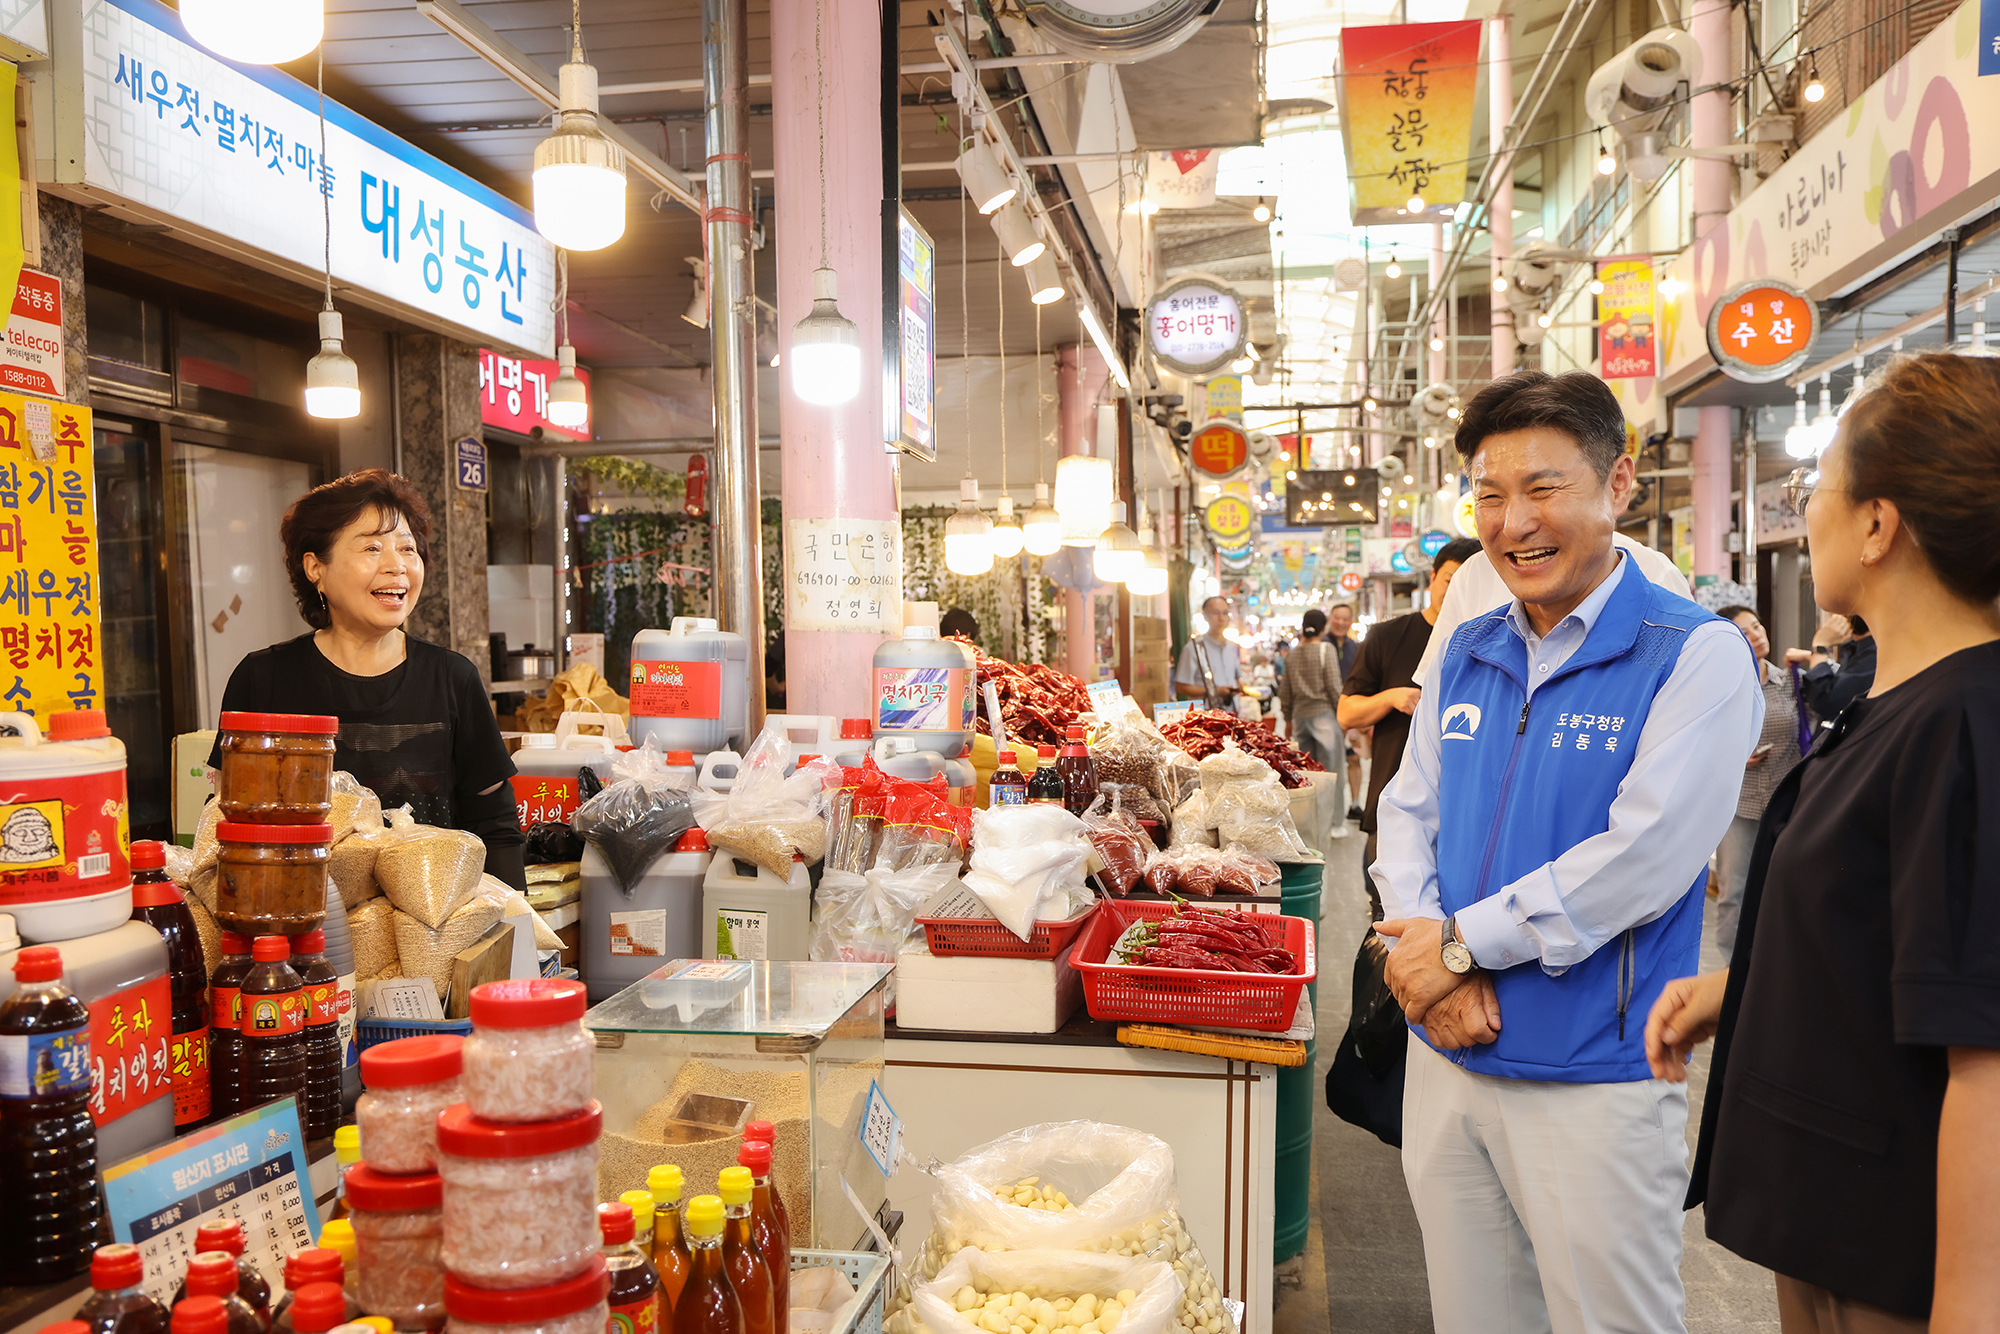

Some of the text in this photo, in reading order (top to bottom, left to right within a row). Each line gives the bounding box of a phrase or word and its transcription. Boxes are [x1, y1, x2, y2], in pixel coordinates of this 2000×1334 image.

[360, 170, 527, 326] 대성농산
[18, 284, 55, 313] 작동중
[1740, 301, 1785, 318] 대양
[1156, 314, 1235, 338] 홍어명가
[1730, 318, 1797, 349] 수산
[5, 347, 42, 364] 케이티텔레캅
[7, 327, 59, 358] telecop
[3, 369, 46, 388] 1588-0112
[1201, 431, 1235, 470] 떡
[462, 461, 482, 485] 26
[0, 462, 87, 516] 참기름
[0, 514, 90, 566] 마늘
[0, 568, 91, 617] 새우젓
[826, 600, 881, 619] 정영희
[0, 622, 93, 670] 멸치젓
[882, 684, 946, 704] 멸치진국
[1556, 712, 1626, 732] 도봉구청장
[1551, 731, 1618, 753] 김동욱
[532, 781, 571, 803] 추자
[726, 917, 744, 931] 할매
[106, 997, 152, 1050] 추자
[172, 1142, 250, 1191] 원산지 표시판
[151, 1161, 281, 1230] 표시품목 원산지 가격
